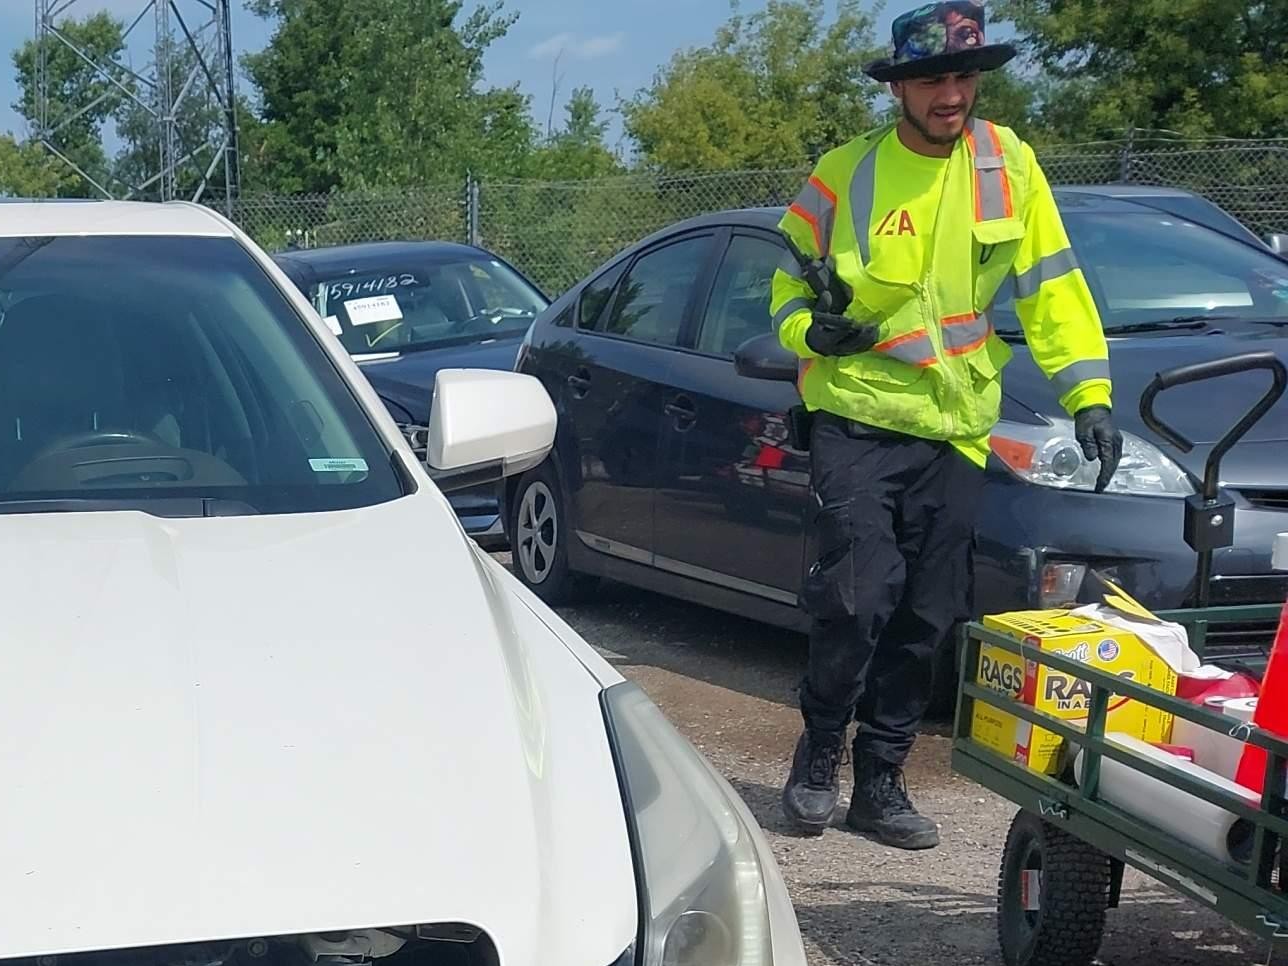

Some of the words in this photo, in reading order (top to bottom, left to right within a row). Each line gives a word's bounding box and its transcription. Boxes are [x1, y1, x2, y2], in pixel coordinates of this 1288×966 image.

[980, 656, 1022, 693] RAGS
[1057, 700, 1071, 710] IN
[1073, 700, 1085, 709] A
